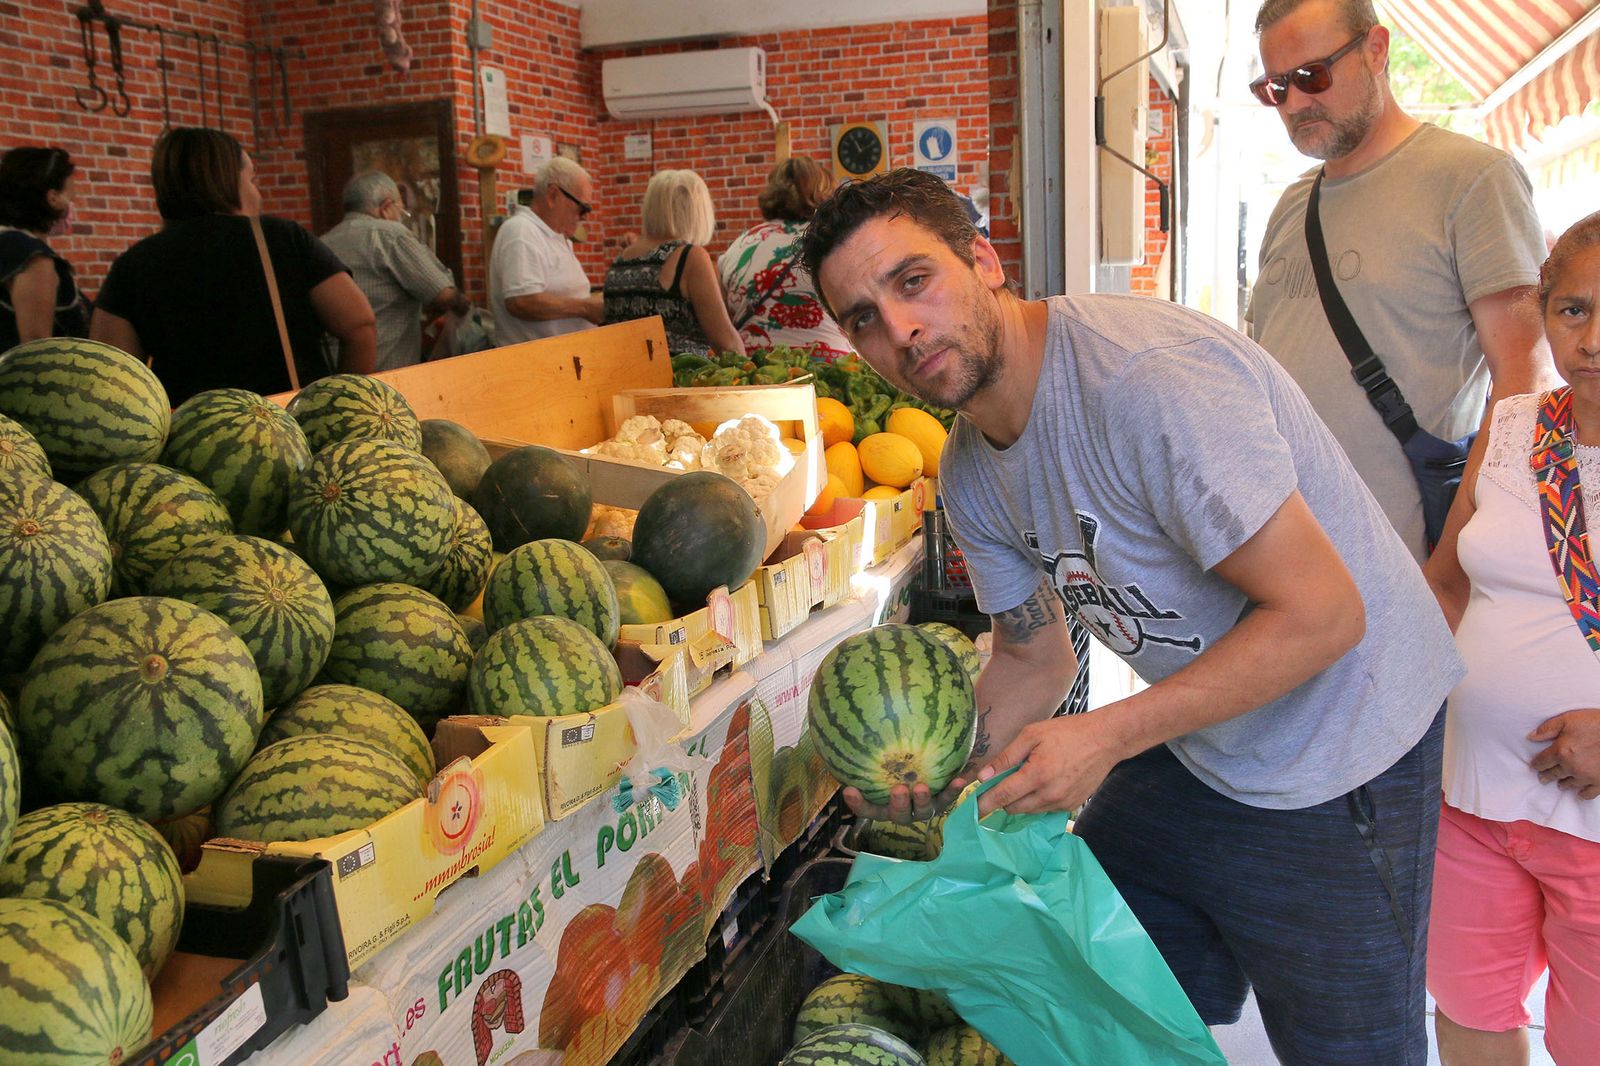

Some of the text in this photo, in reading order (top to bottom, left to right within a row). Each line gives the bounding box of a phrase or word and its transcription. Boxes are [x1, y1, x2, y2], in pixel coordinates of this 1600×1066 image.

[348, 939, 371, 960] RIVOIRA
[437, 884, 545, 1014] FRUTAS
[551, 850, 580, 899] EL
